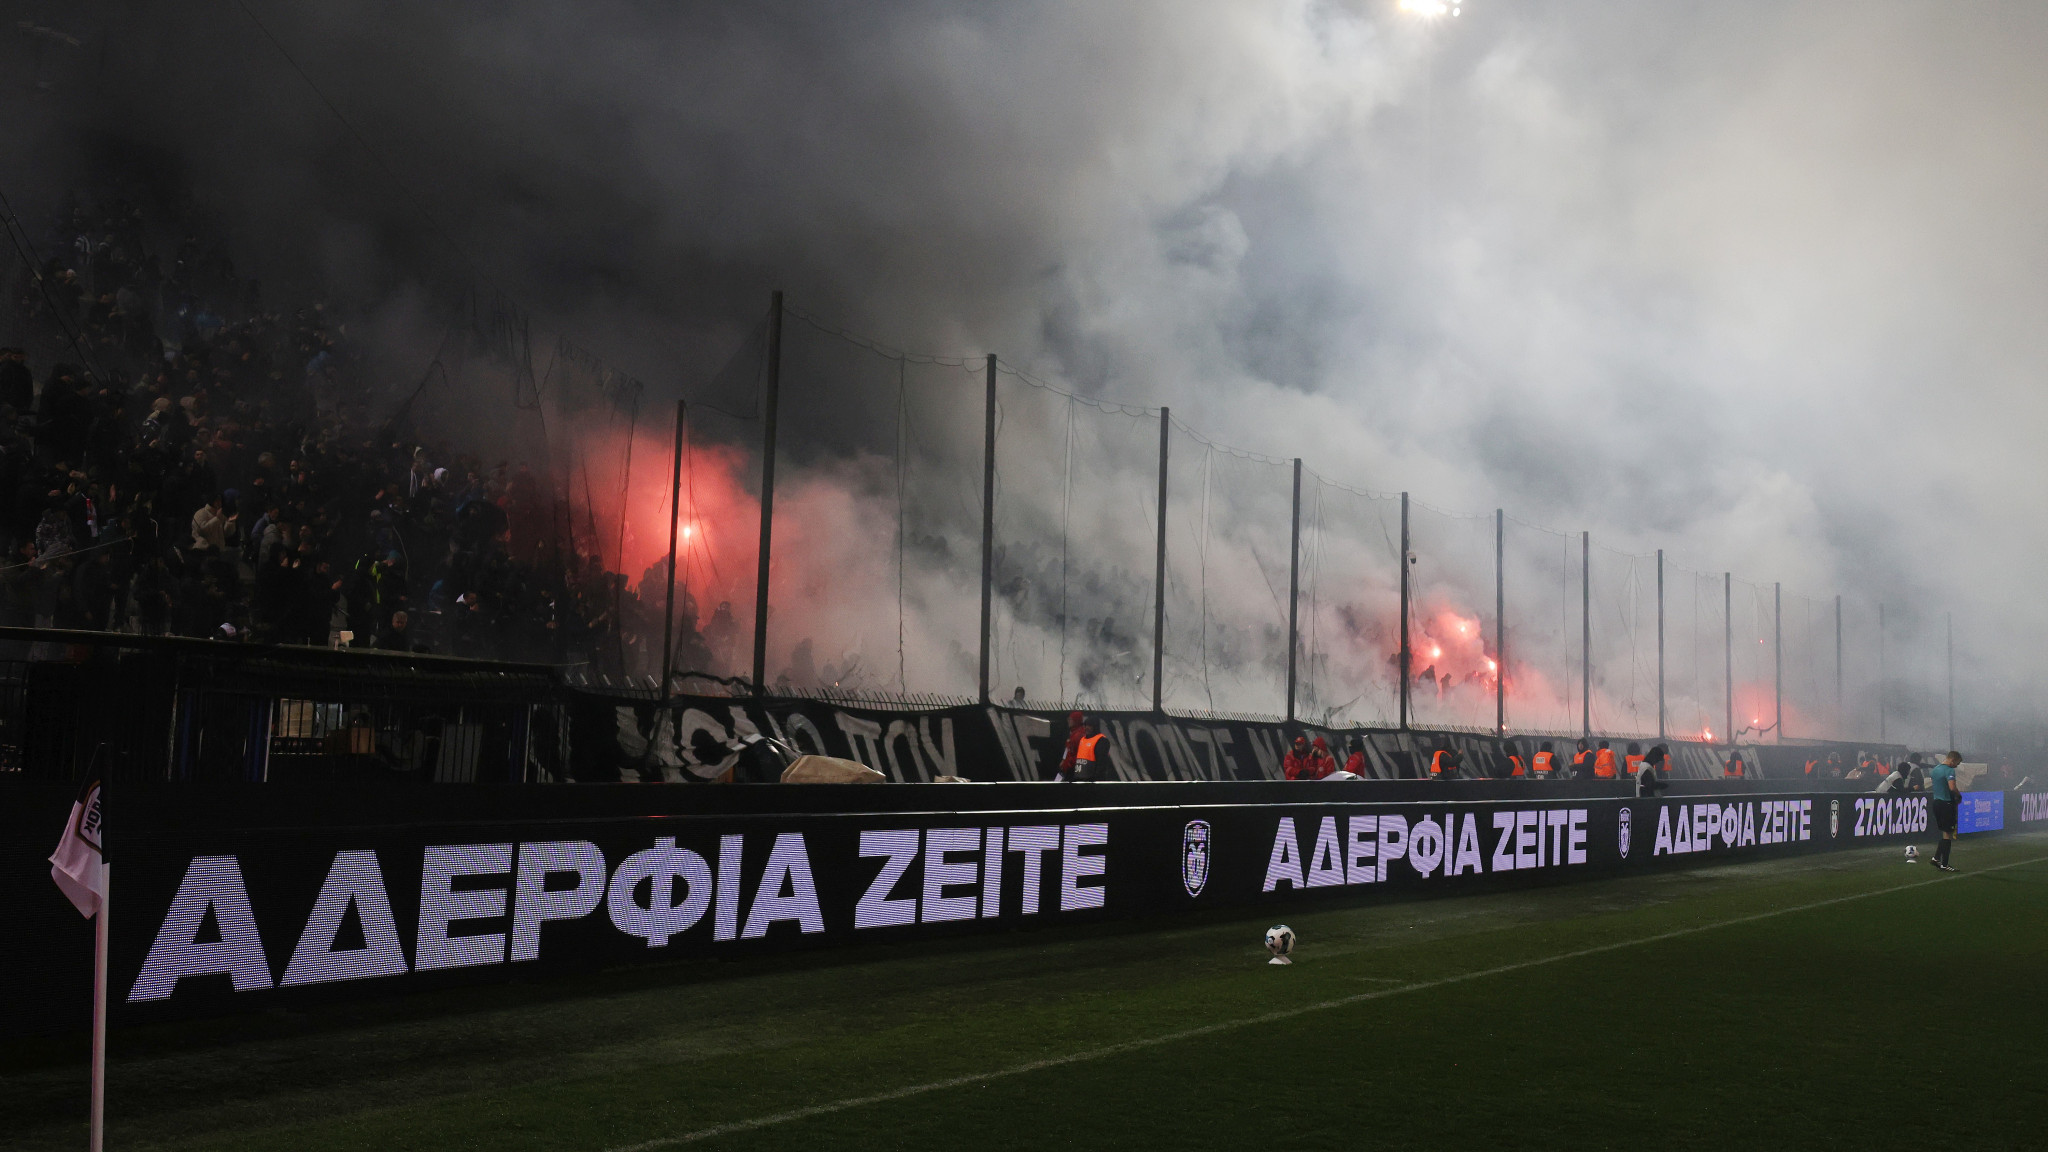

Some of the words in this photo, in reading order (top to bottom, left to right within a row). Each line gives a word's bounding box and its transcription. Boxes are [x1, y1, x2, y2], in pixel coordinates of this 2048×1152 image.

[1262, 812, 1483, 893] ΑΔΕΡΦΙΑ
[1492, 809, 1588, 873] ΖΕΙΤΕ
[1653, 802, 1756, 856] ΑΔΕΡΦΙΑ
[1760, 800, 1812, 844] ΖΕΙΤΕ
[1855, 797, 1928, 837] 27.01.2026
[126, 832, 826, 1004] ΑΔΕΡΦΙΑ
[854, 822, 1109, 929] ΖΕΙΤΕ
